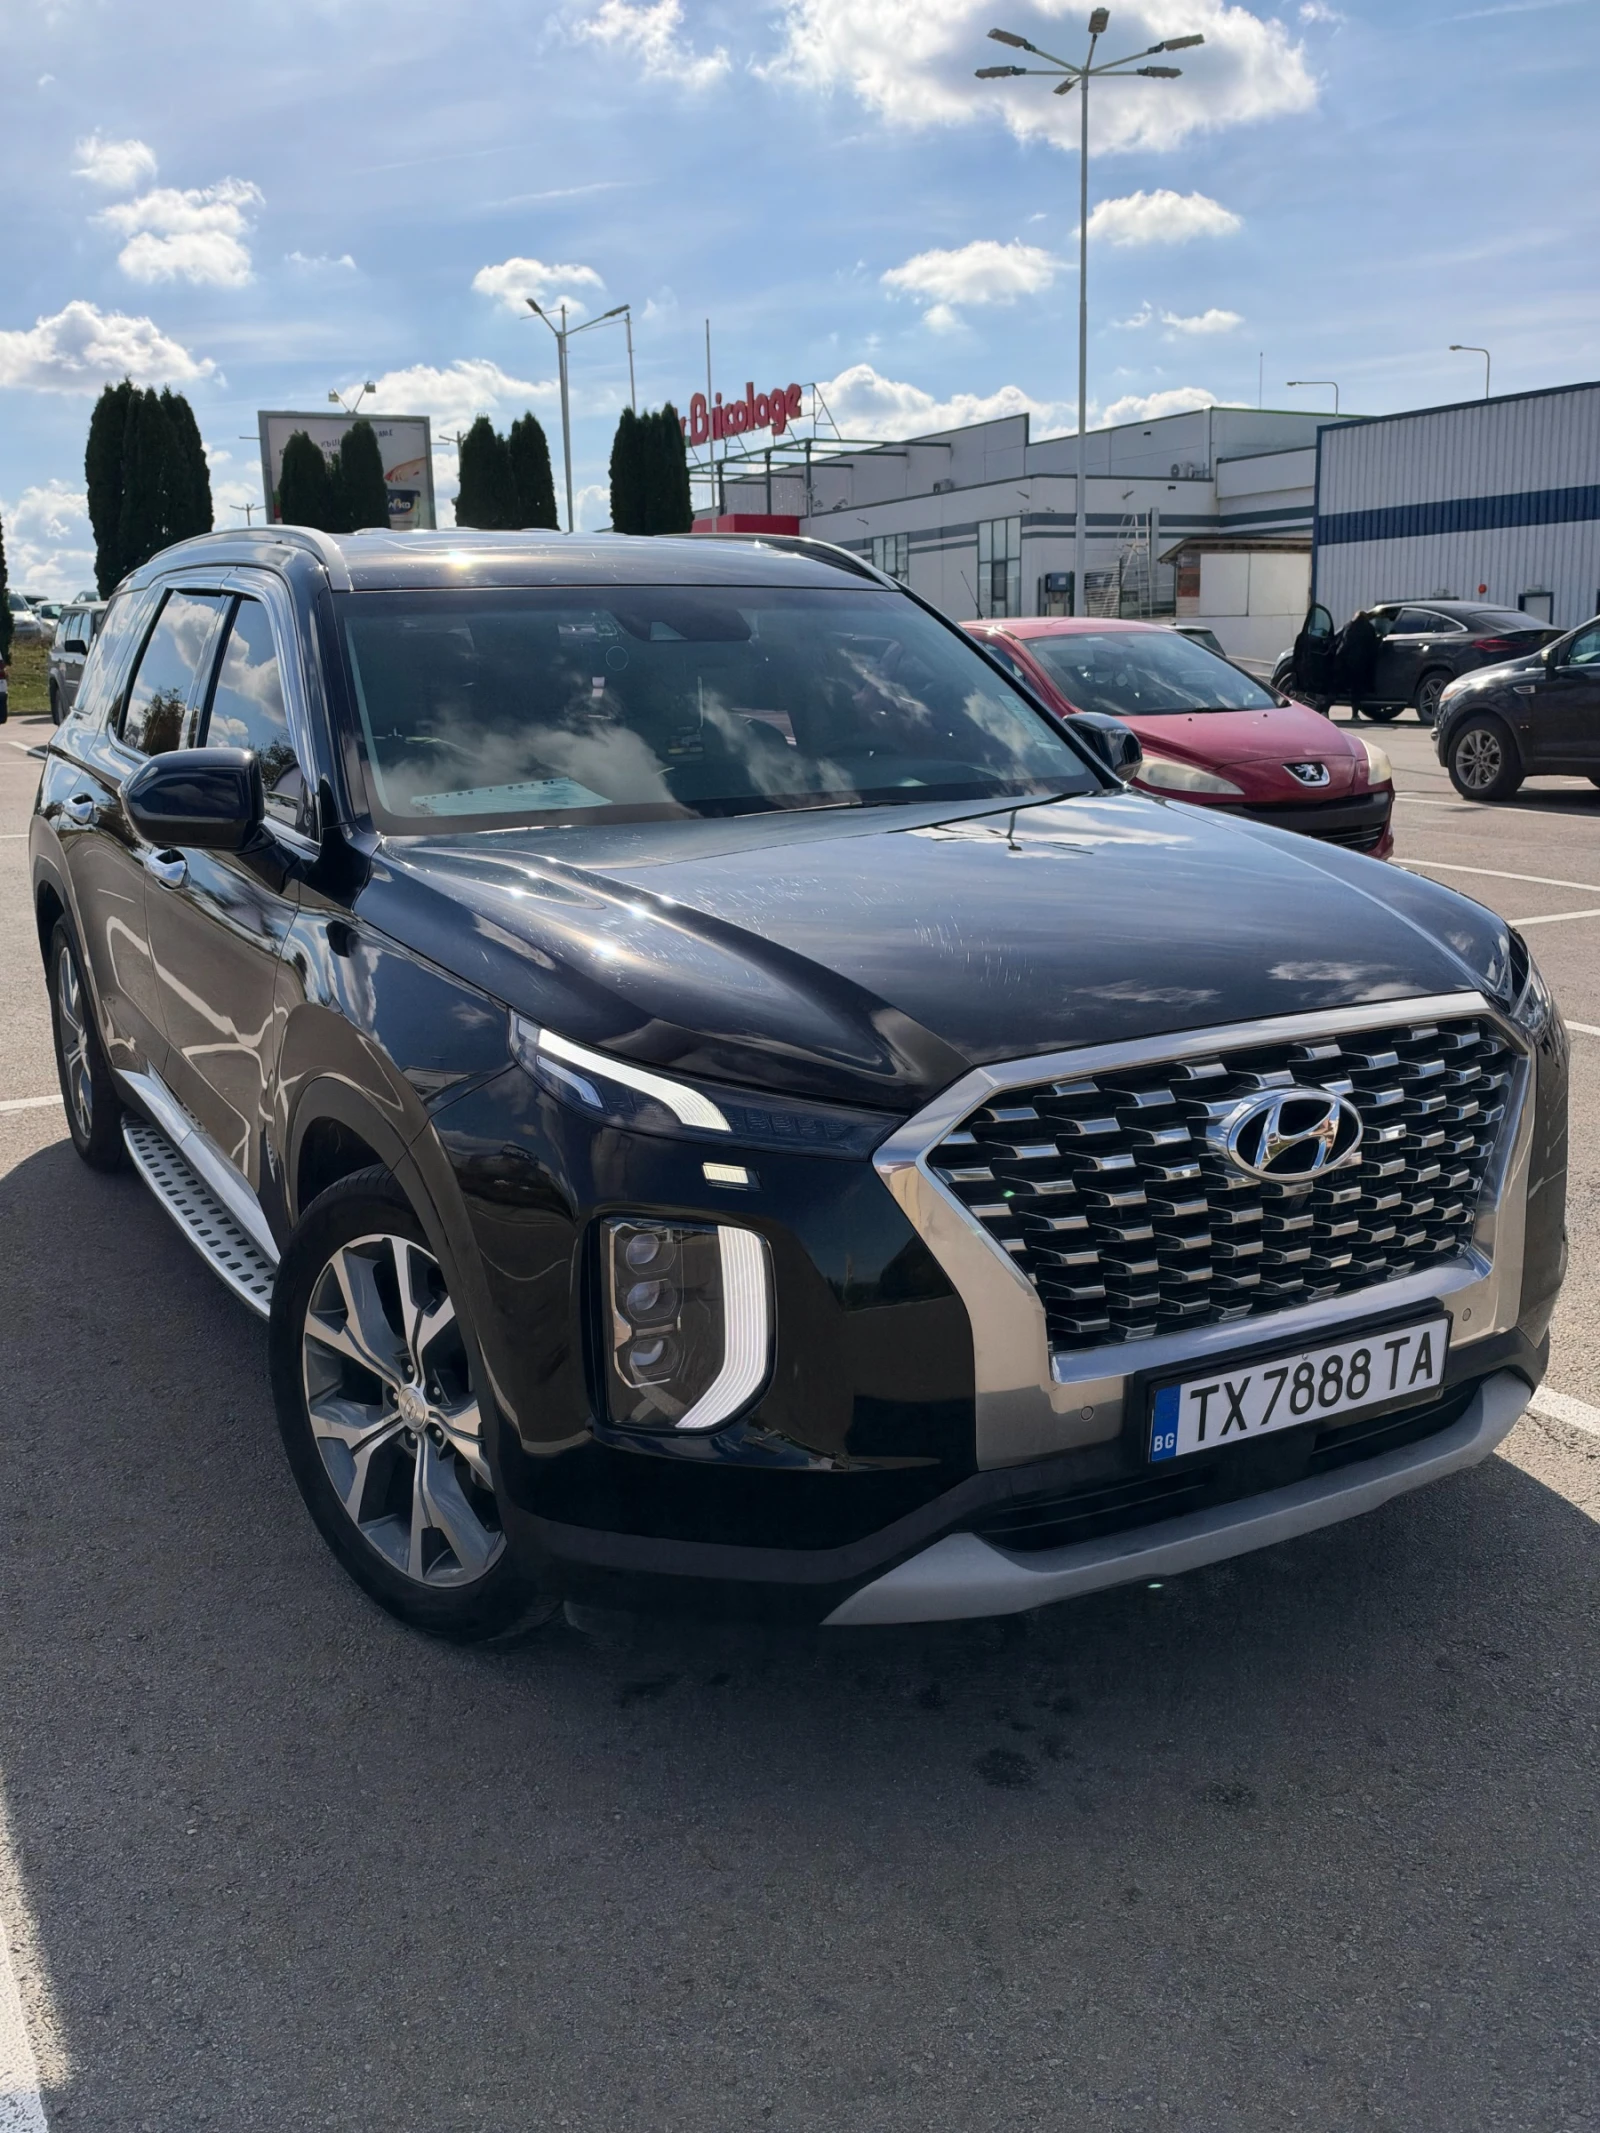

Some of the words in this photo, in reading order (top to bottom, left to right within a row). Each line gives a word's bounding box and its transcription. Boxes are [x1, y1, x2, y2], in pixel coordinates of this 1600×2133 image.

[1190, 1376, 1251, 1442] TX
[1260, 1348, 1371, 1426] 7888
[1385, 1331, 1433, 1391] TA
[1154, 1432, 1175, 1452] BG
